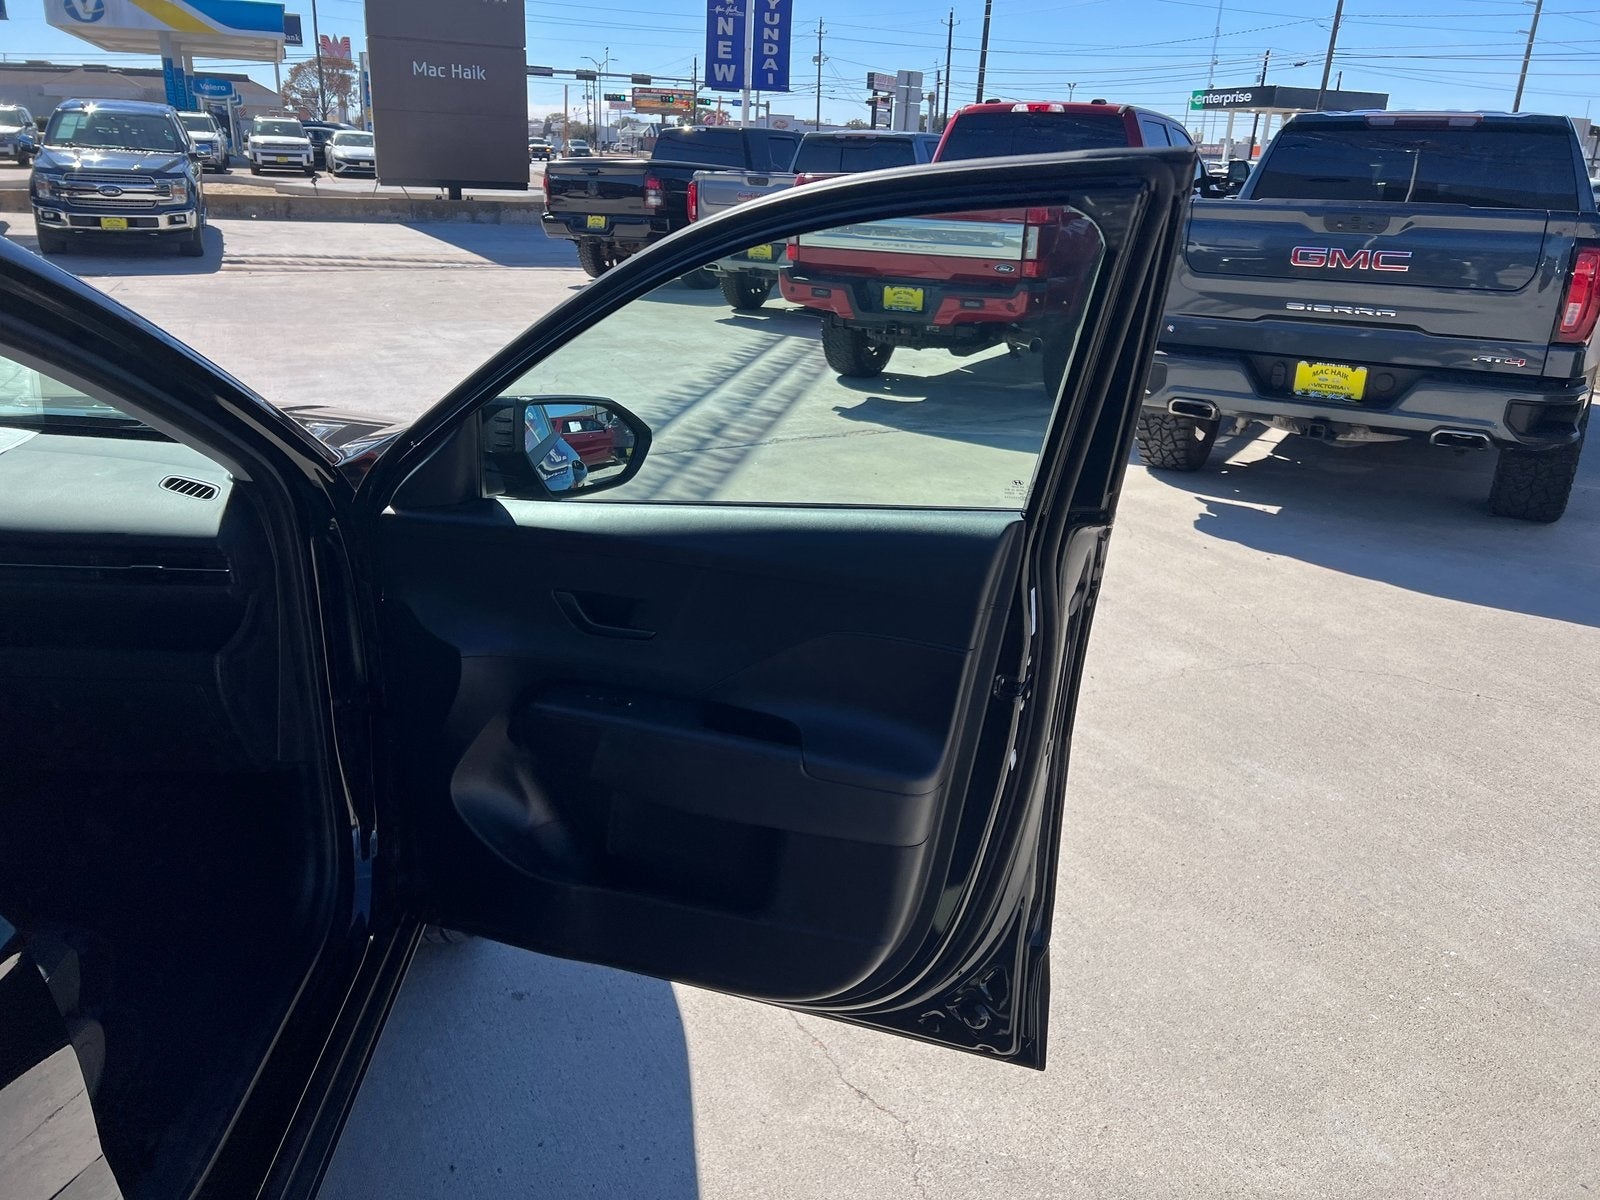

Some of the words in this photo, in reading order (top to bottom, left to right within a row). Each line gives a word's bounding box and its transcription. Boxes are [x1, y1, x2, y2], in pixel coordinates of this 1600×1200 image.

[713, 16, 736, 82] NEW
[412, 60, 446, 78] Mac
[451, 63, 486, 80] Haik
[199, 82, 226, 91] Valero
[1193, 90, 1252, 106] enterprise
[1290, 246, 1412, 272] GMC
[1286, 302, 1397, 317] SIERRA
[1472, 354, 1526, 367] AT4
[1312, 368, 1329, 377] MAC
[1330, 369, 1350, 381] HAIK
[1313, 382, 1344, 390] VICTORIA
